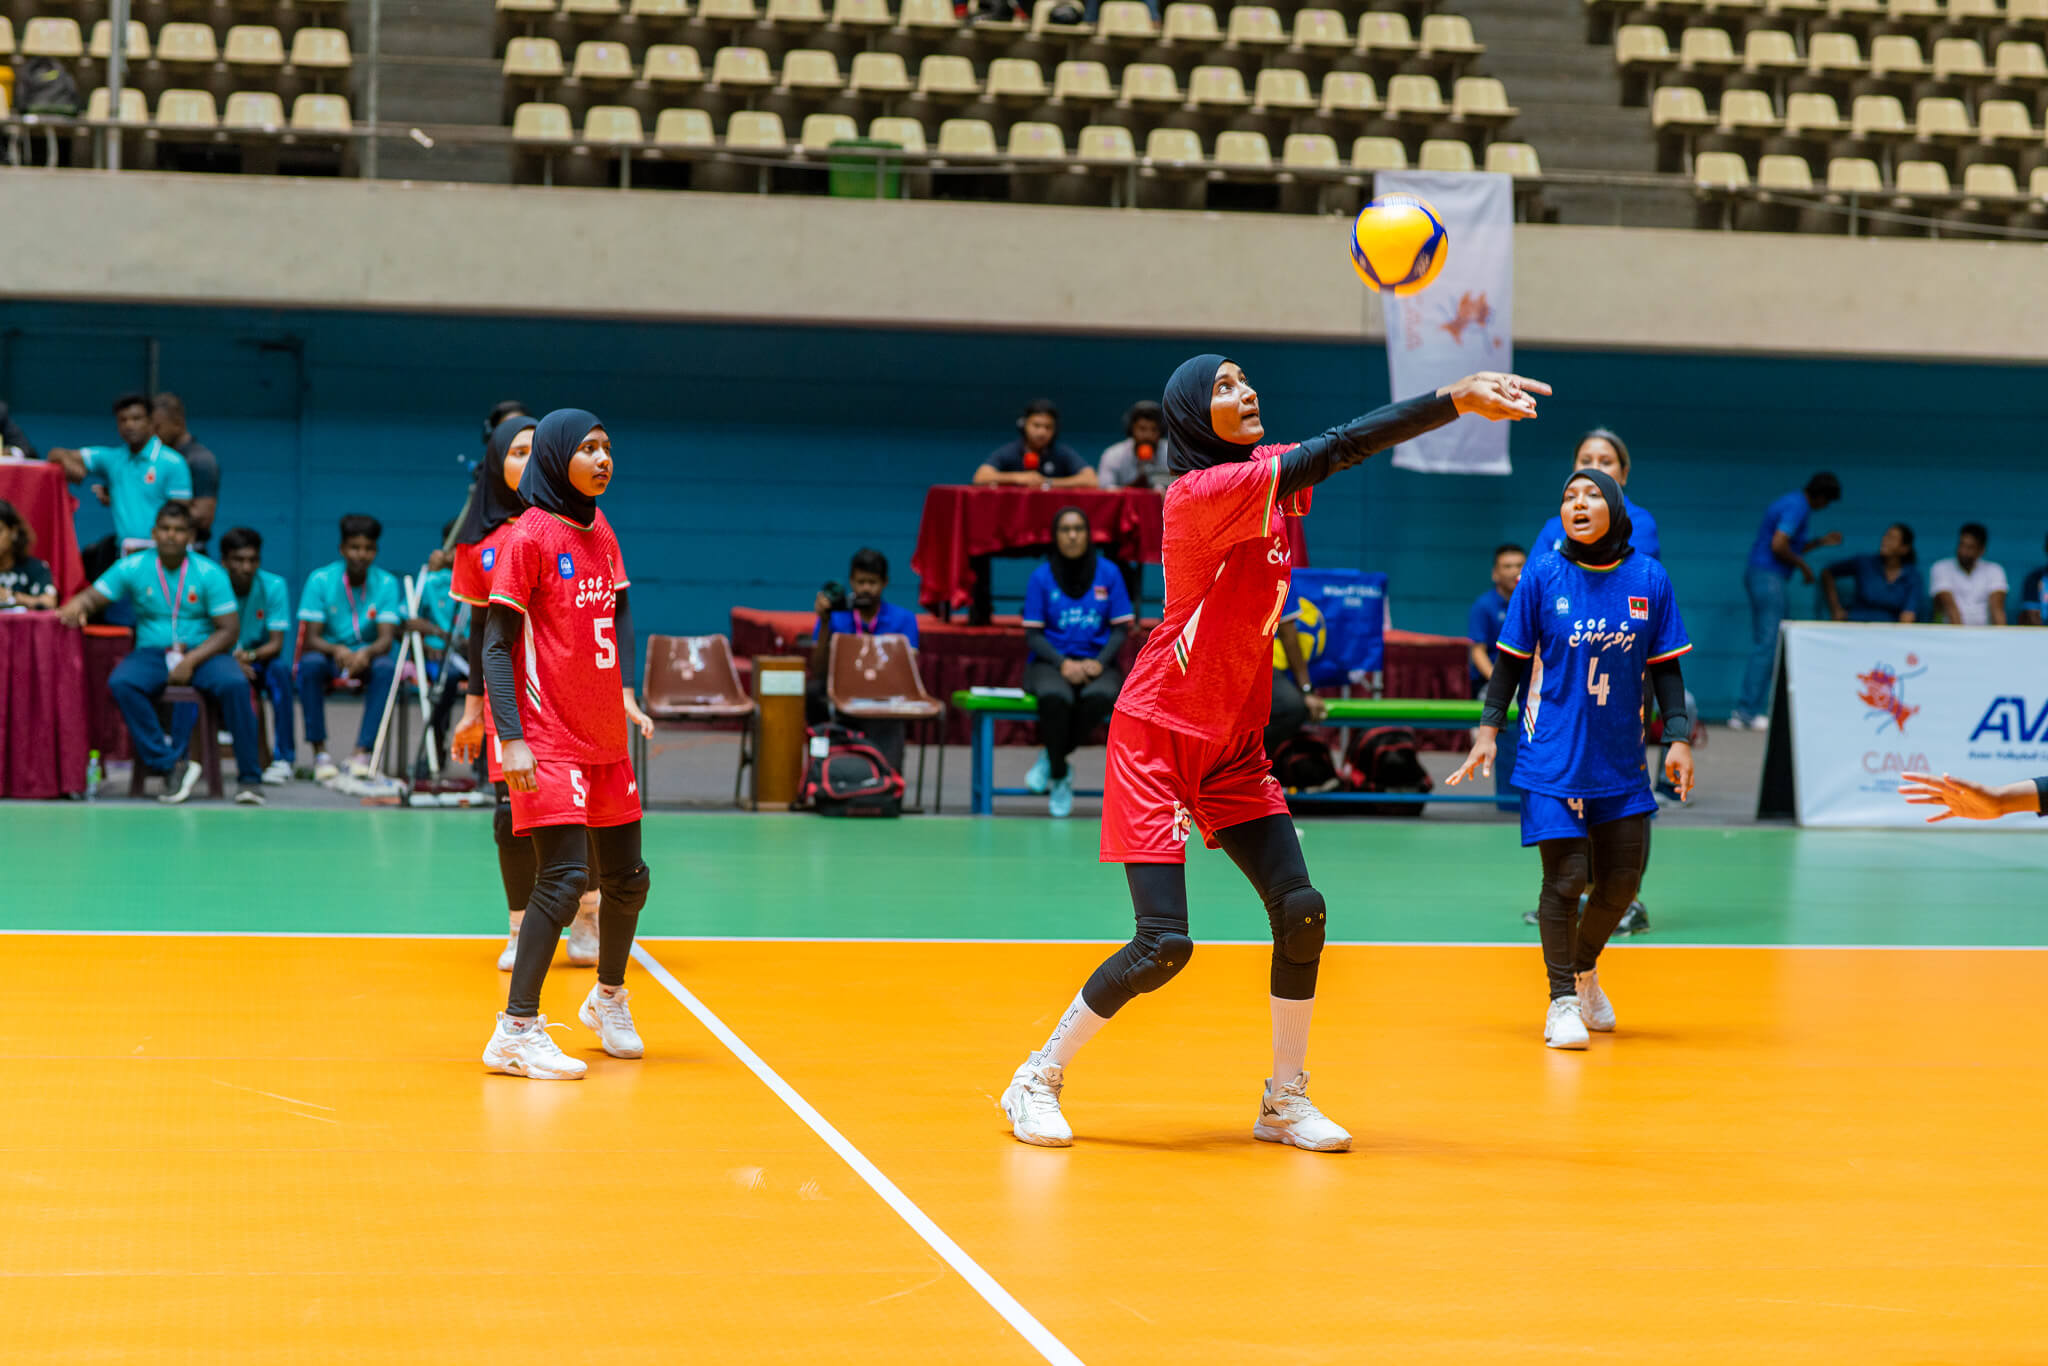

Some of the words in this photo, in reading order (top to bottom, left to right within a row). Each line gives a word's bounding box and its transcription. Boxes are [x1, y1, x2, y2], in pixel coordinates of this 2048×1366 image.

[593, 617, 616, 669] 5
[1587, 657, 1610, 706] 4
[1861, 752, 1930, 774] CAVA
[570, 769, 586, 807] 5
